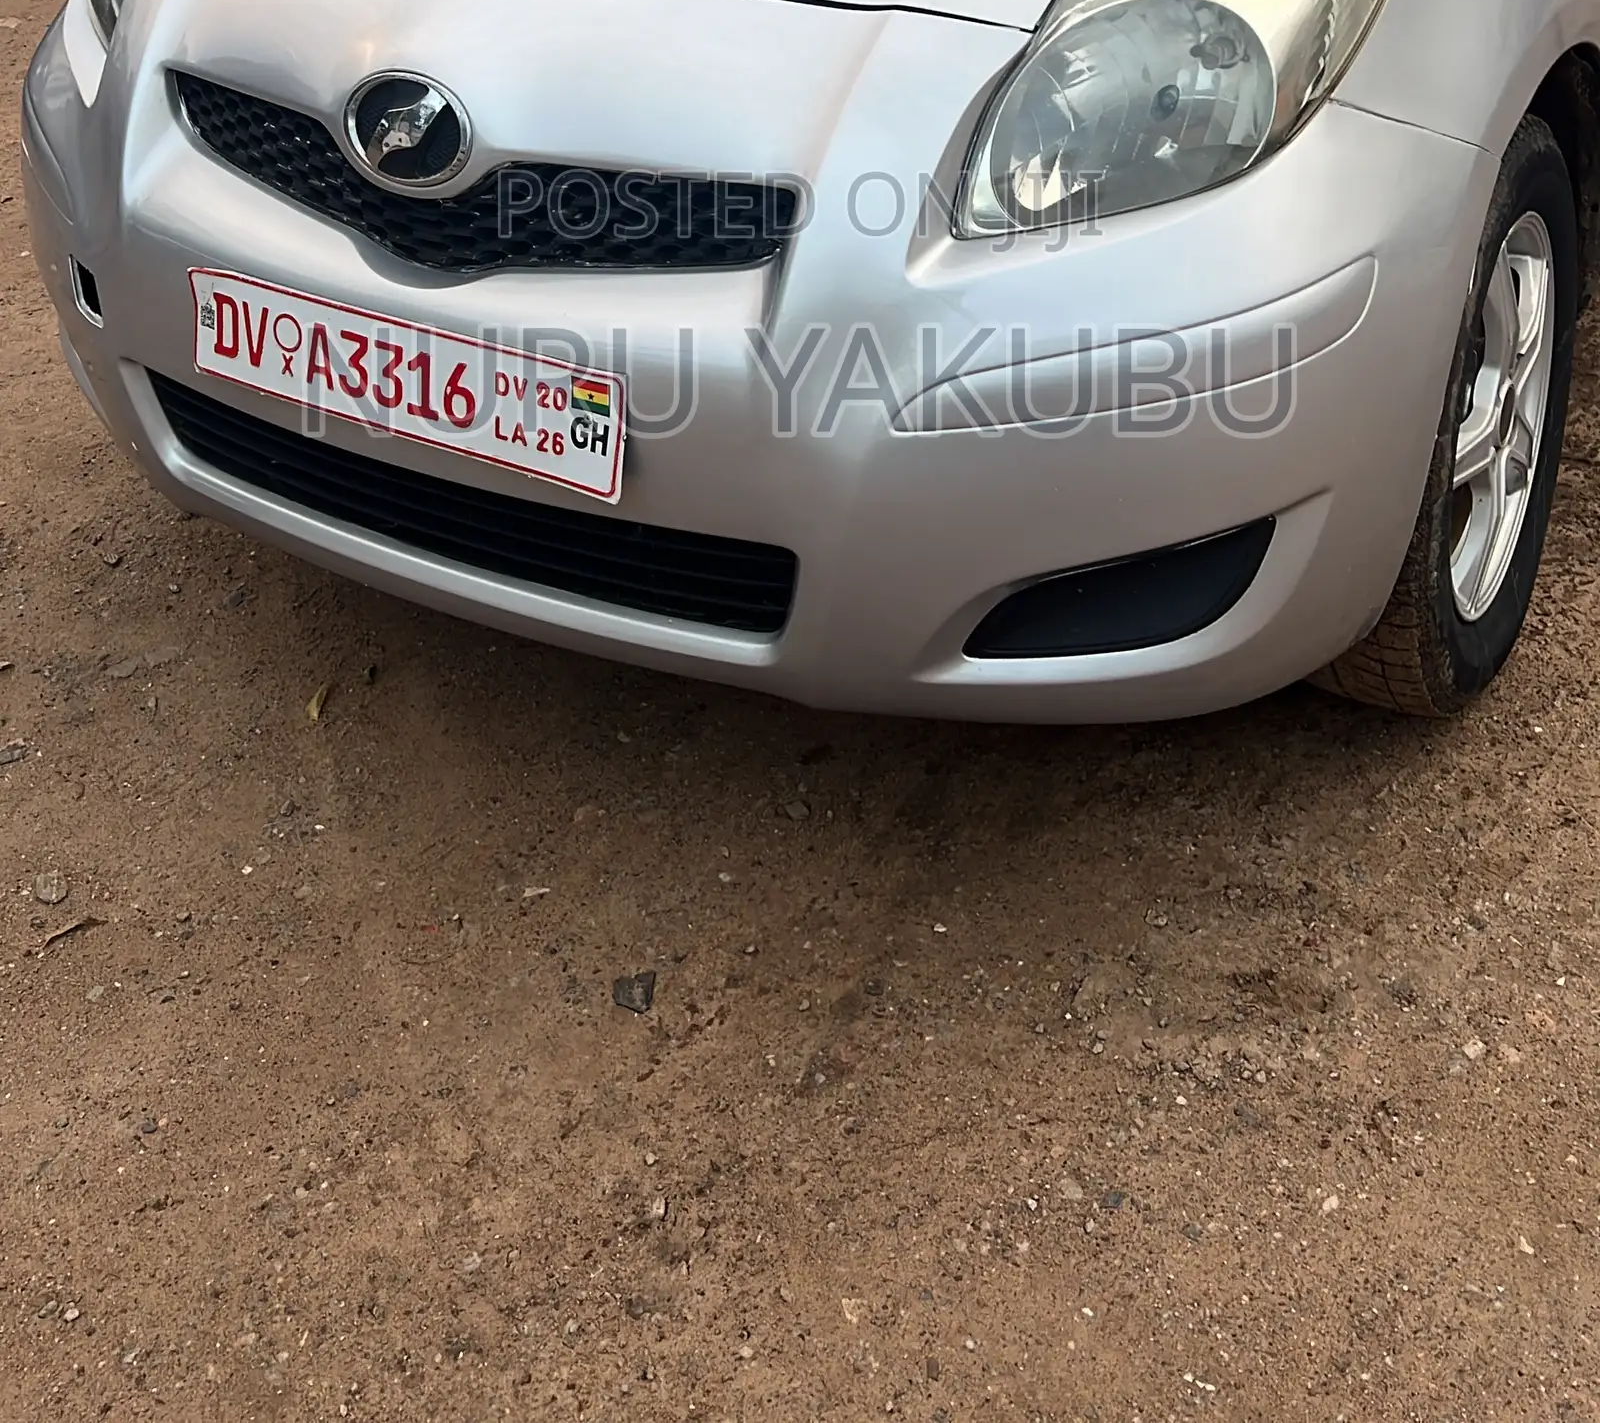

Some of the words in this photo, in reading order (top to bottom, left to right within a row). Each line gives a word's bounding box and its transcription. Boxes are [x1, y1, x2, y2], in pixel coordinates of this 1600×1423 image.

[213, 292, 269, 368] DV
[306, 322, 476, 428] A3316
[495, 372, 528, 401] DV
[536, 382, 567, 411] 20
[495, 416, 527, 446] LA
[536, 428, 564, 455] 26
[571, 416, 609, 456] GH
